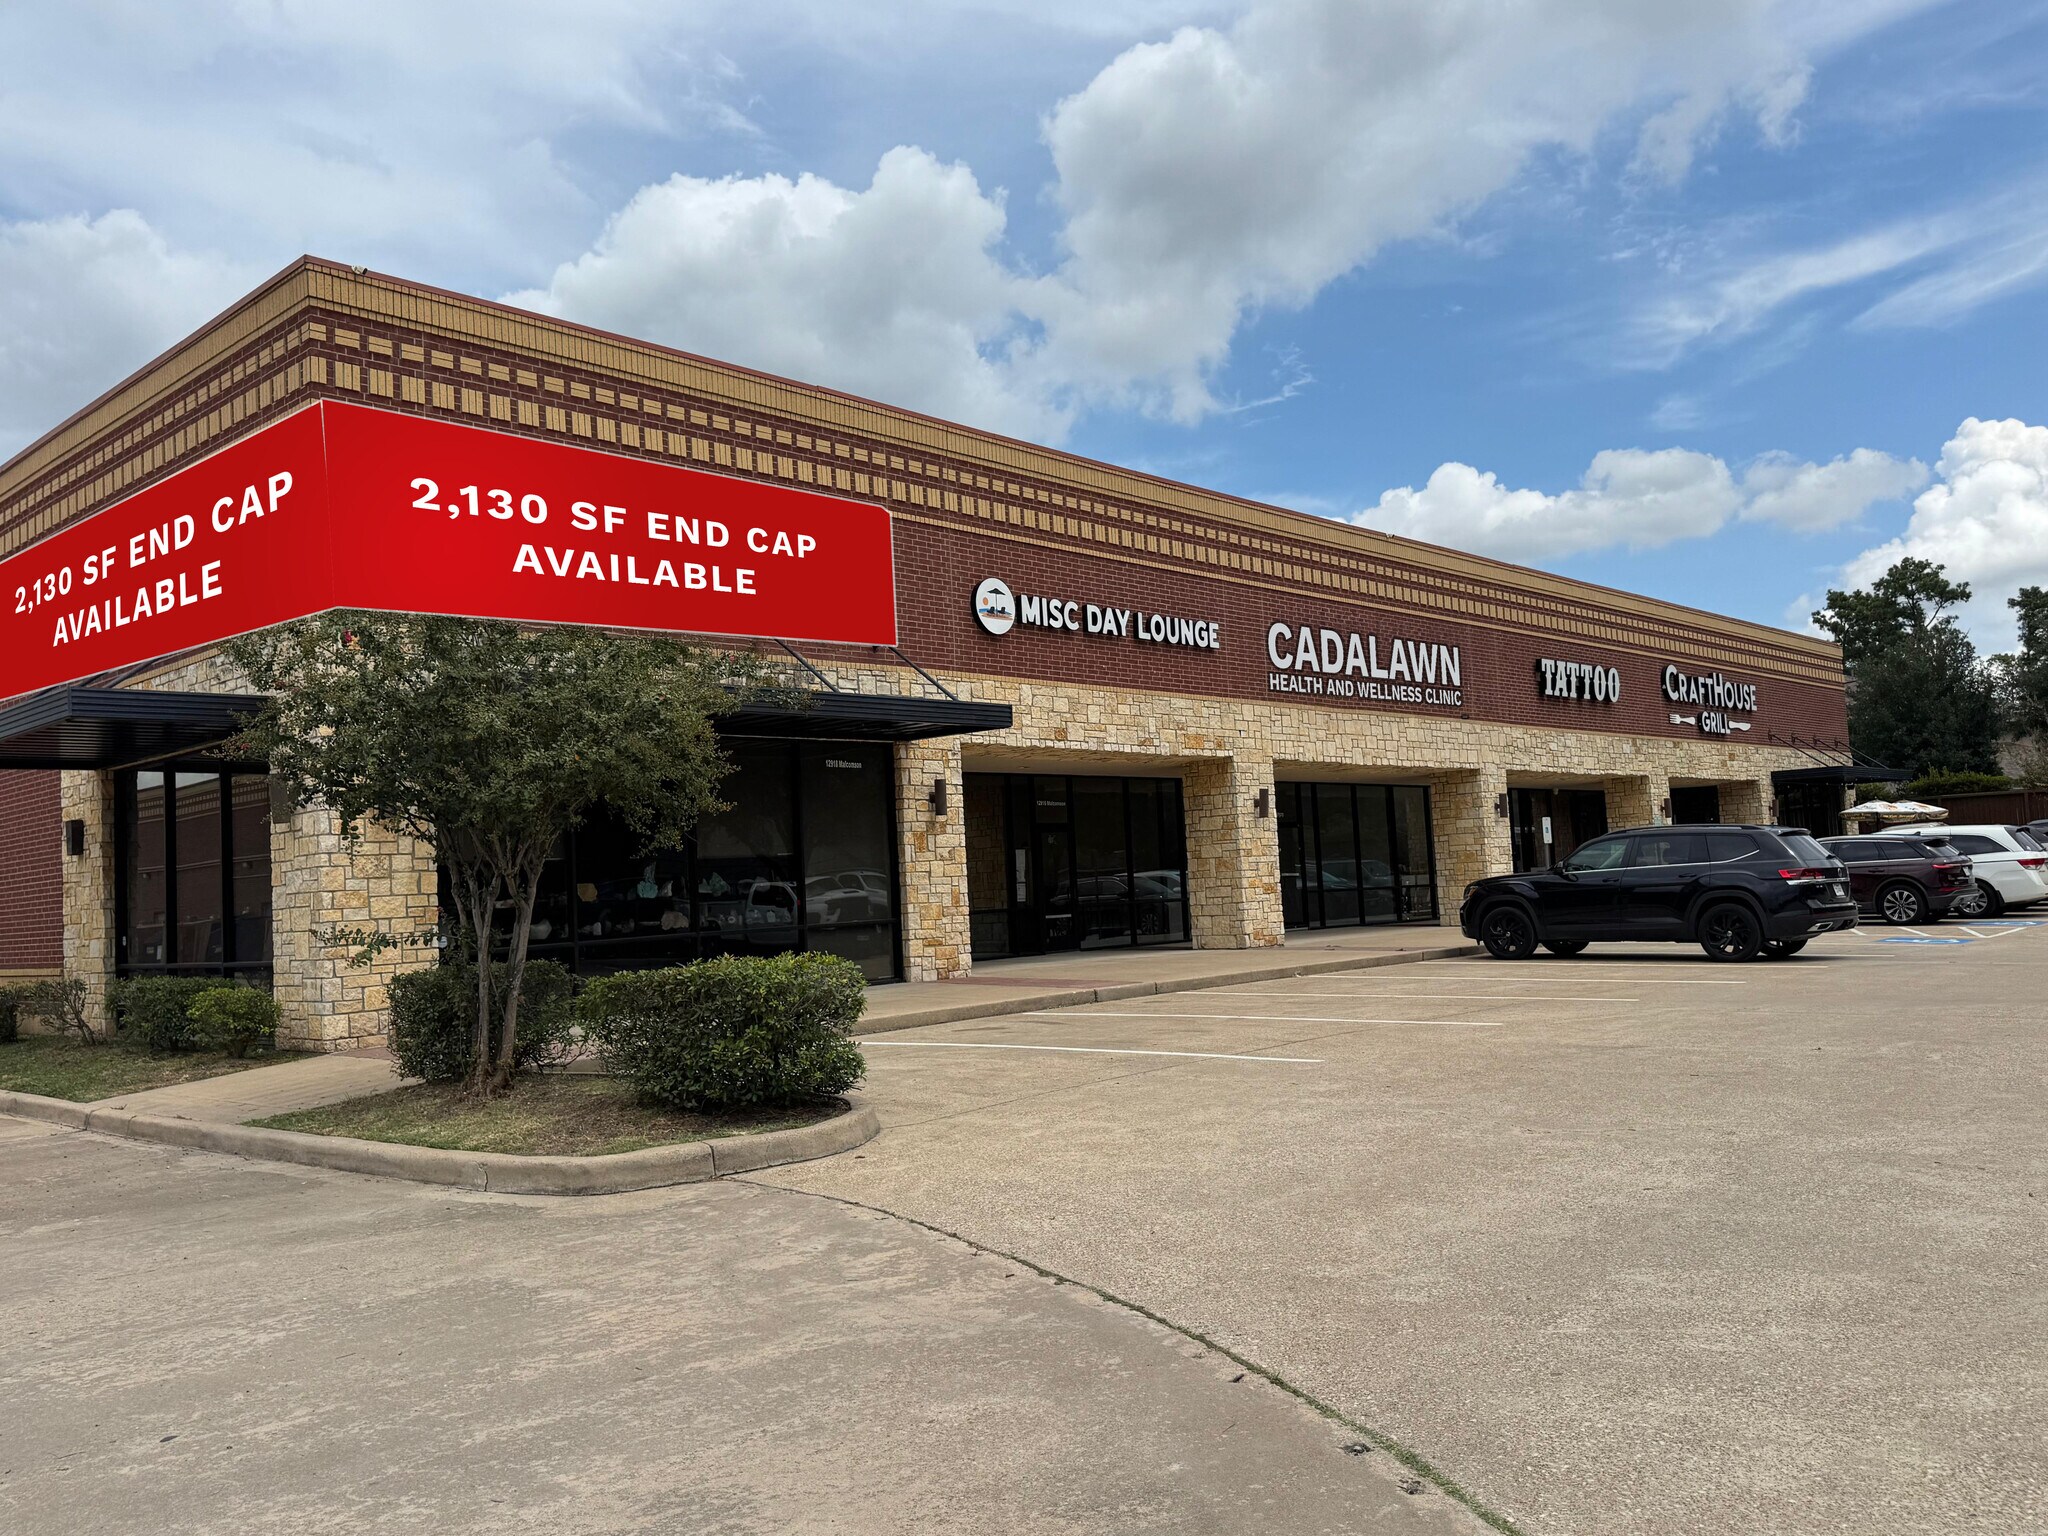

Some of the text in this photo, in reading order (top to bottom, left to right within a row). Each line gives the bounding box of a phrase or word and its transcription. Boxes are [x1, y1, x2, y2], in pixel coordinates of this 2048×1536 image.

[1020, 594, 1220, 649] MISC DAY LOUNGE
[1267, 622, 1461, 687] CADALAWN
[1269, 673, 1462, 706] HEALTH AND WELLNESS CLINIC
[1541, 658, 1620, 703] TATTOO
[1702, 711, 1731, 734] GRILL
